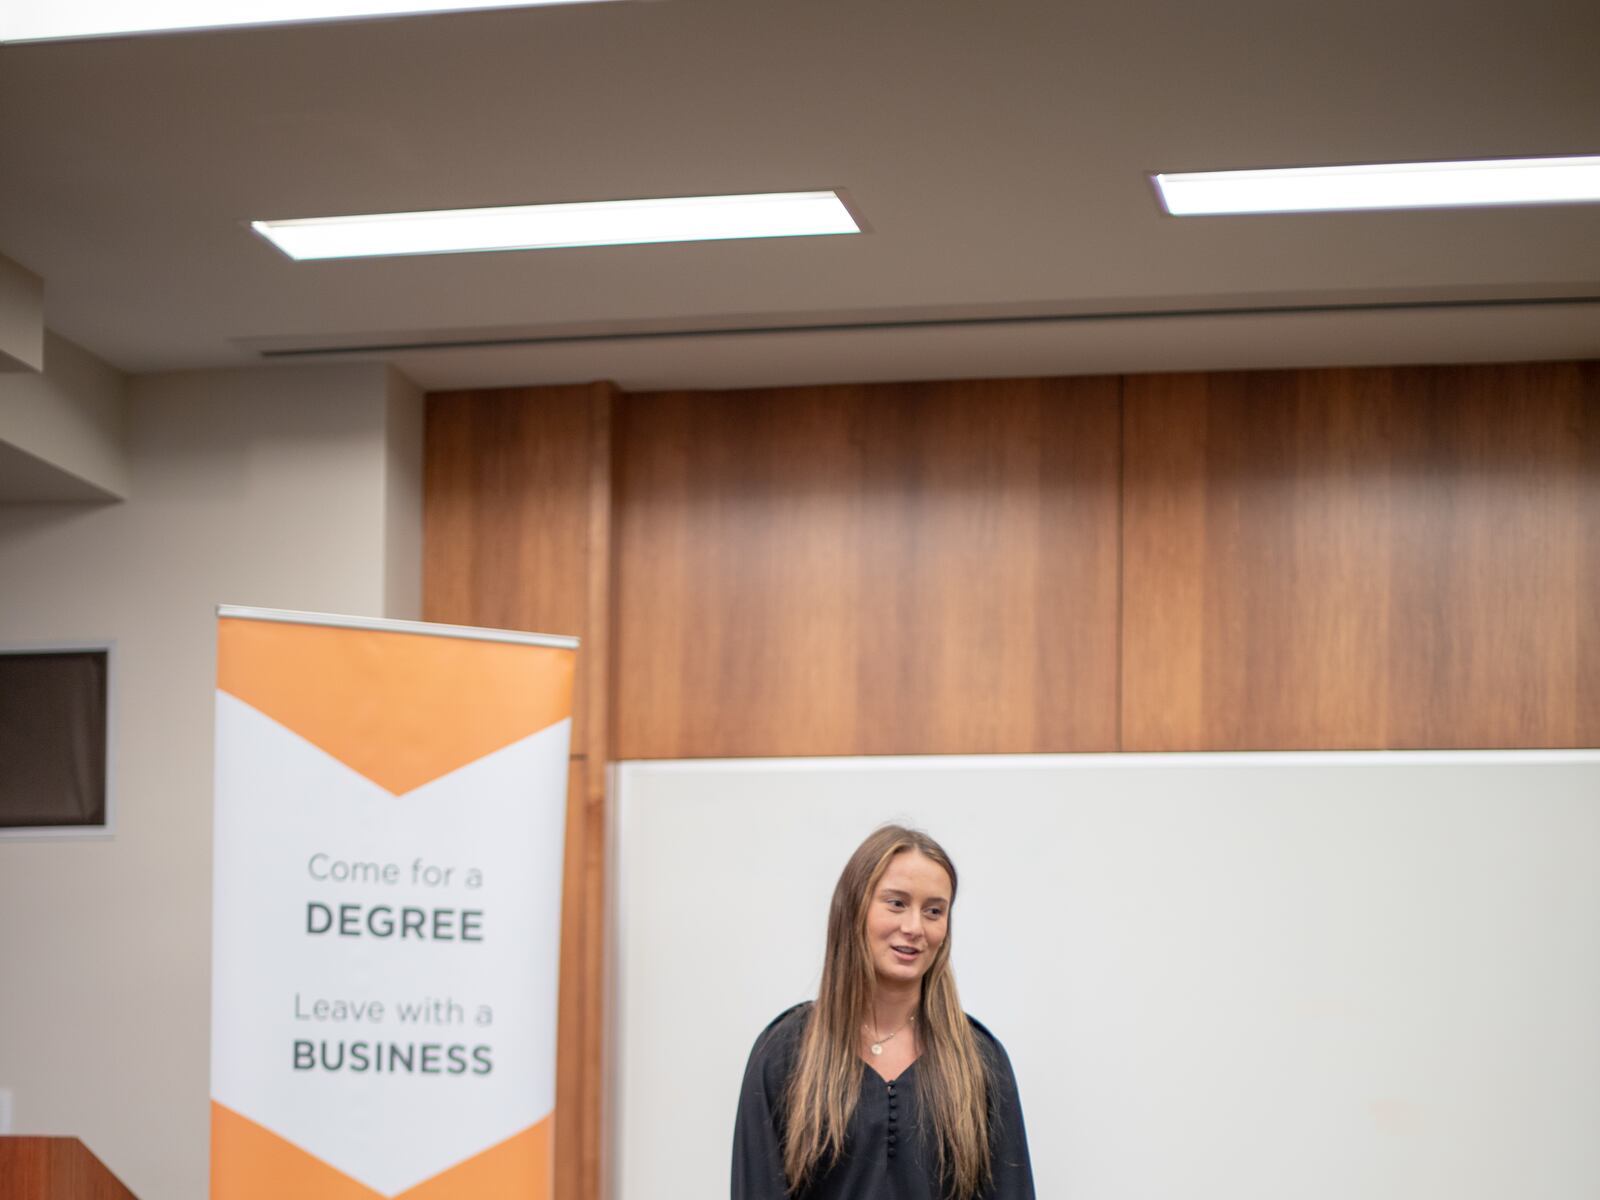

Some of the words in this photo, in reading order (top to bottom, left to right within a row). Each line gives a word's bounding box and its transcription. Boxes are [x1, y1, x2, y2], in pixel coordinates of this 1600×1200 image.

[308, 853, 400, 885] Come
[411, 858, 454, 887] for
[465, 868, 484, 889] a
[306, 903, 484, 941] DEGREE
[294, 993, 385, 1023] Leave
[397, 997, 464, 1026] with
[476, 1005, 494, 1026] a
[292, 1040, 493, 1076] BUSINESS
